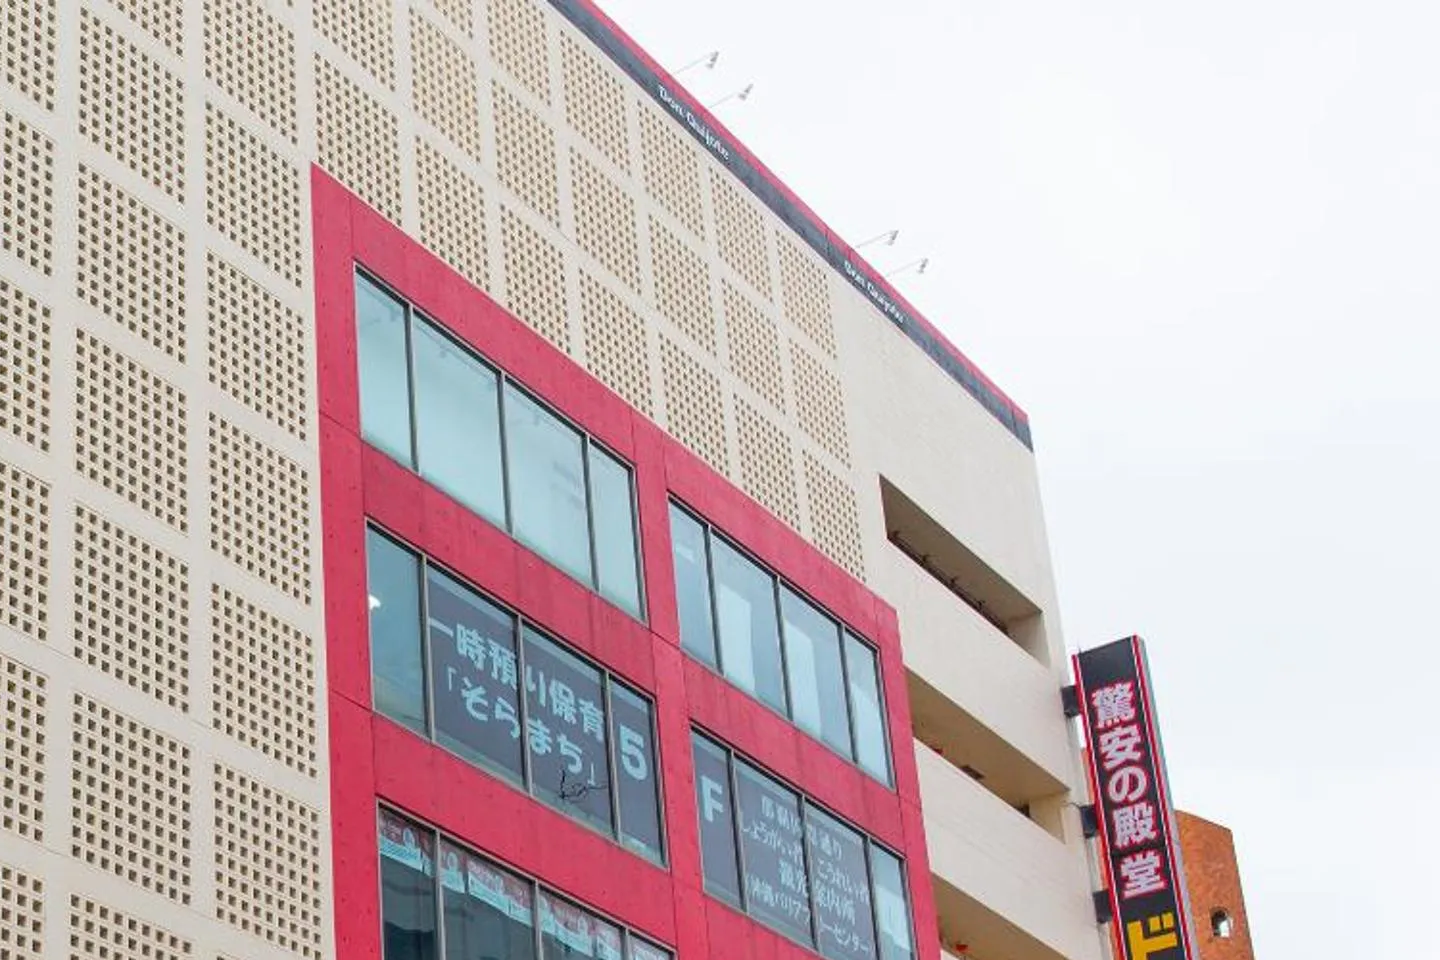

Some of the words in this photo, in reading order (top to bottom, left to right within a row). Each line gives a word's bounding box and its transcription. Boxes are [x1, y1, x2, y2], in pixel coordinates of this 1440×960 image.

[1092, 683, 1169, 900] 驚安の殿堂
